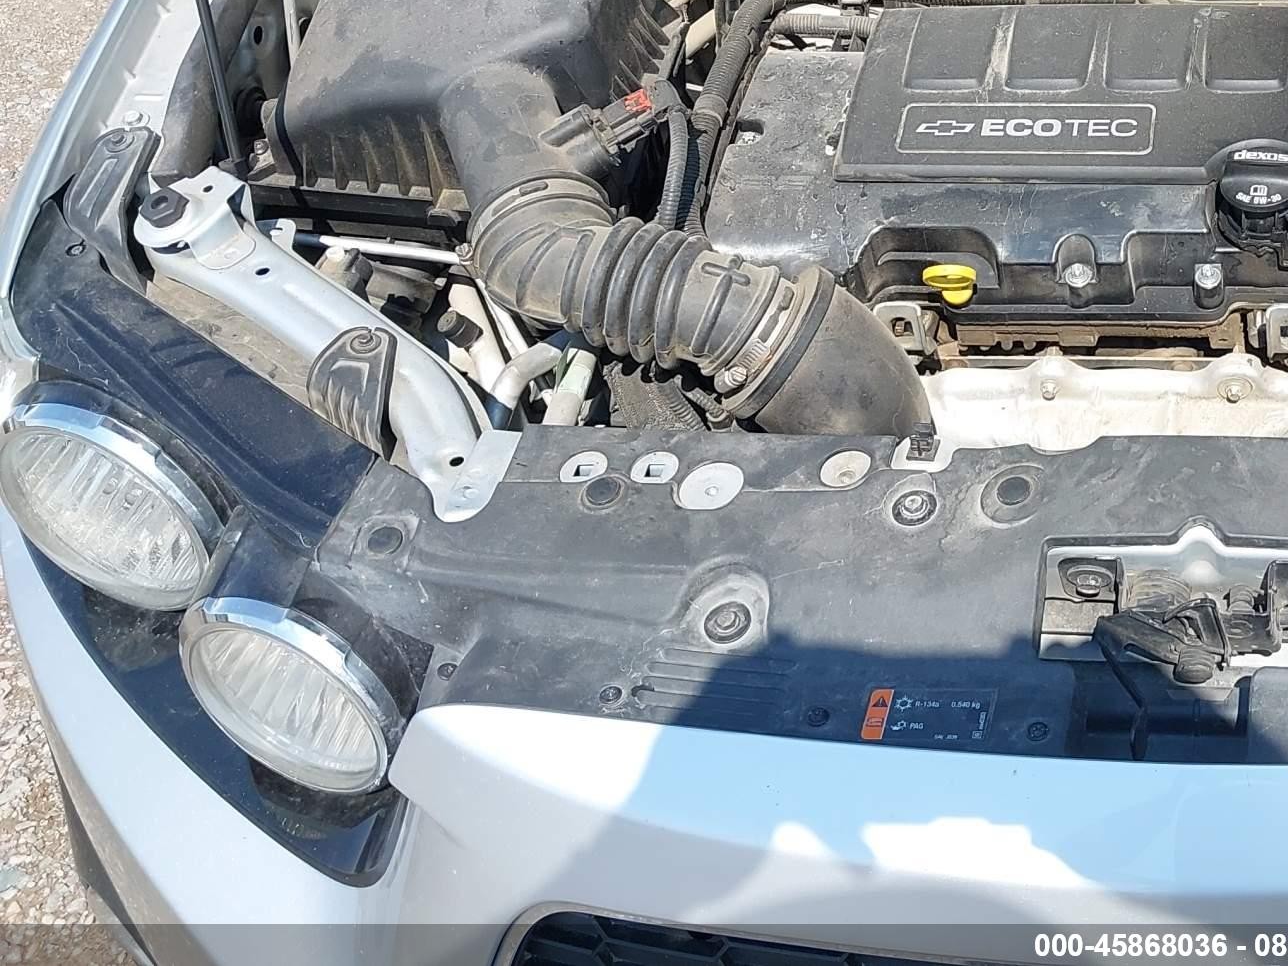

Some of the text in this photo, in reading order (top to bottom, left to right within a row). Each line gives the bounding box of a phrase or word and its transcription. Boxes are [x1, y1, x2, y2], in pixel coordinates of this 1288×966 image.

[980, 118, 1139, 138] ECOTEC
[1235, 192, 1252, 203] SAE
[909, 722, 924, 730] PAG
